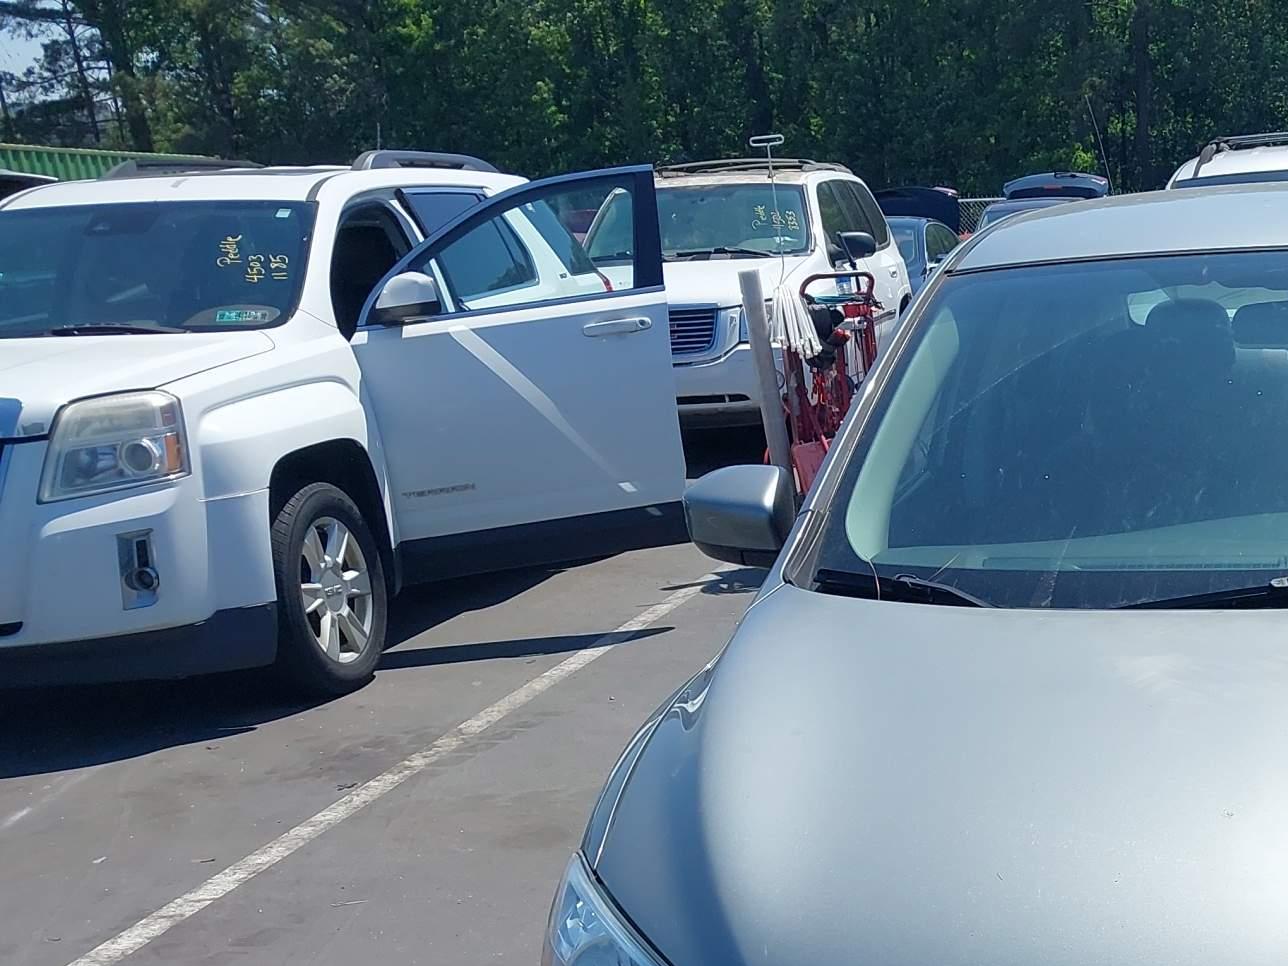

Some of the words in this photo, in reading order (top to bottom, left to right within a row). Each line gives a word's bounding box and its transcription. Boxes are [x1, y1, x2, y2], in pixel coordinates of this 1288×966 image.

[217, 234, 242, 268] Peddle
[245, 254, 265, 283] 4503
[269, 254, 289, 280] 1185
